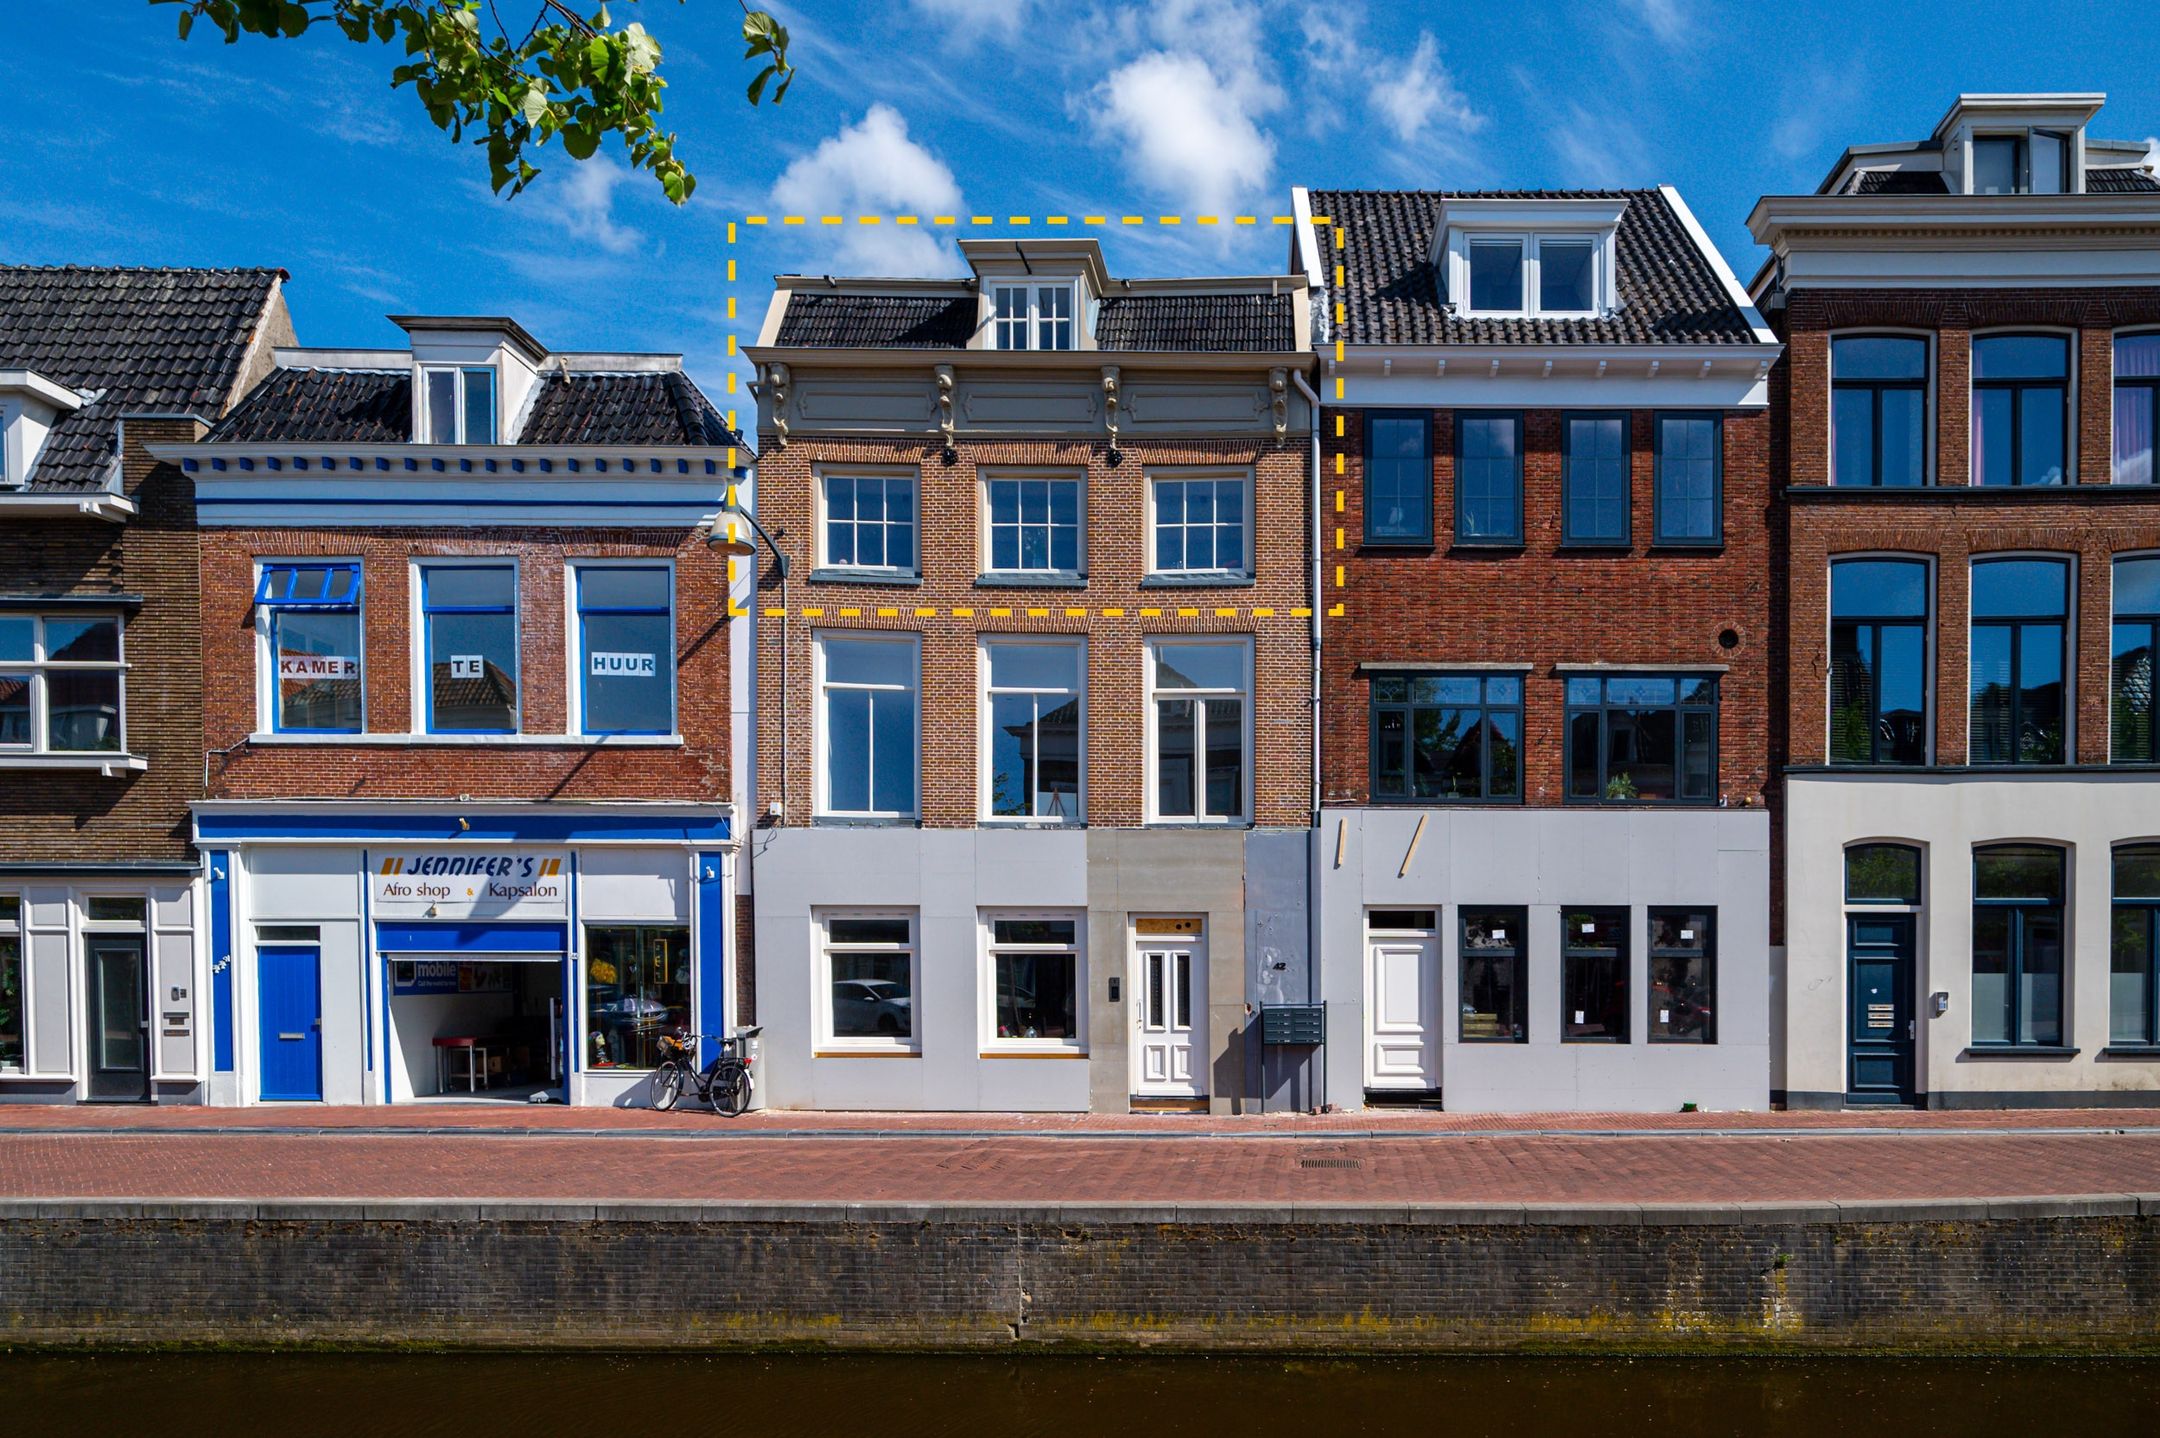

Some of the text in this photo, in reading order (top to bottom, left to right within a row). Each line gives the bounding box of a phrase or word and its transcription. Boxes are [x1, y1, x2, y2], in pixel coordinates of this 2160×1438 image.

[280, 657, 654, 674] KAMER TE HUUR
[407, 856, 534, 877] JENNIFER'S
[383, 882, 558, 899] Afro shop & Kapsalon
[417, 961, 457, 977] mobile
